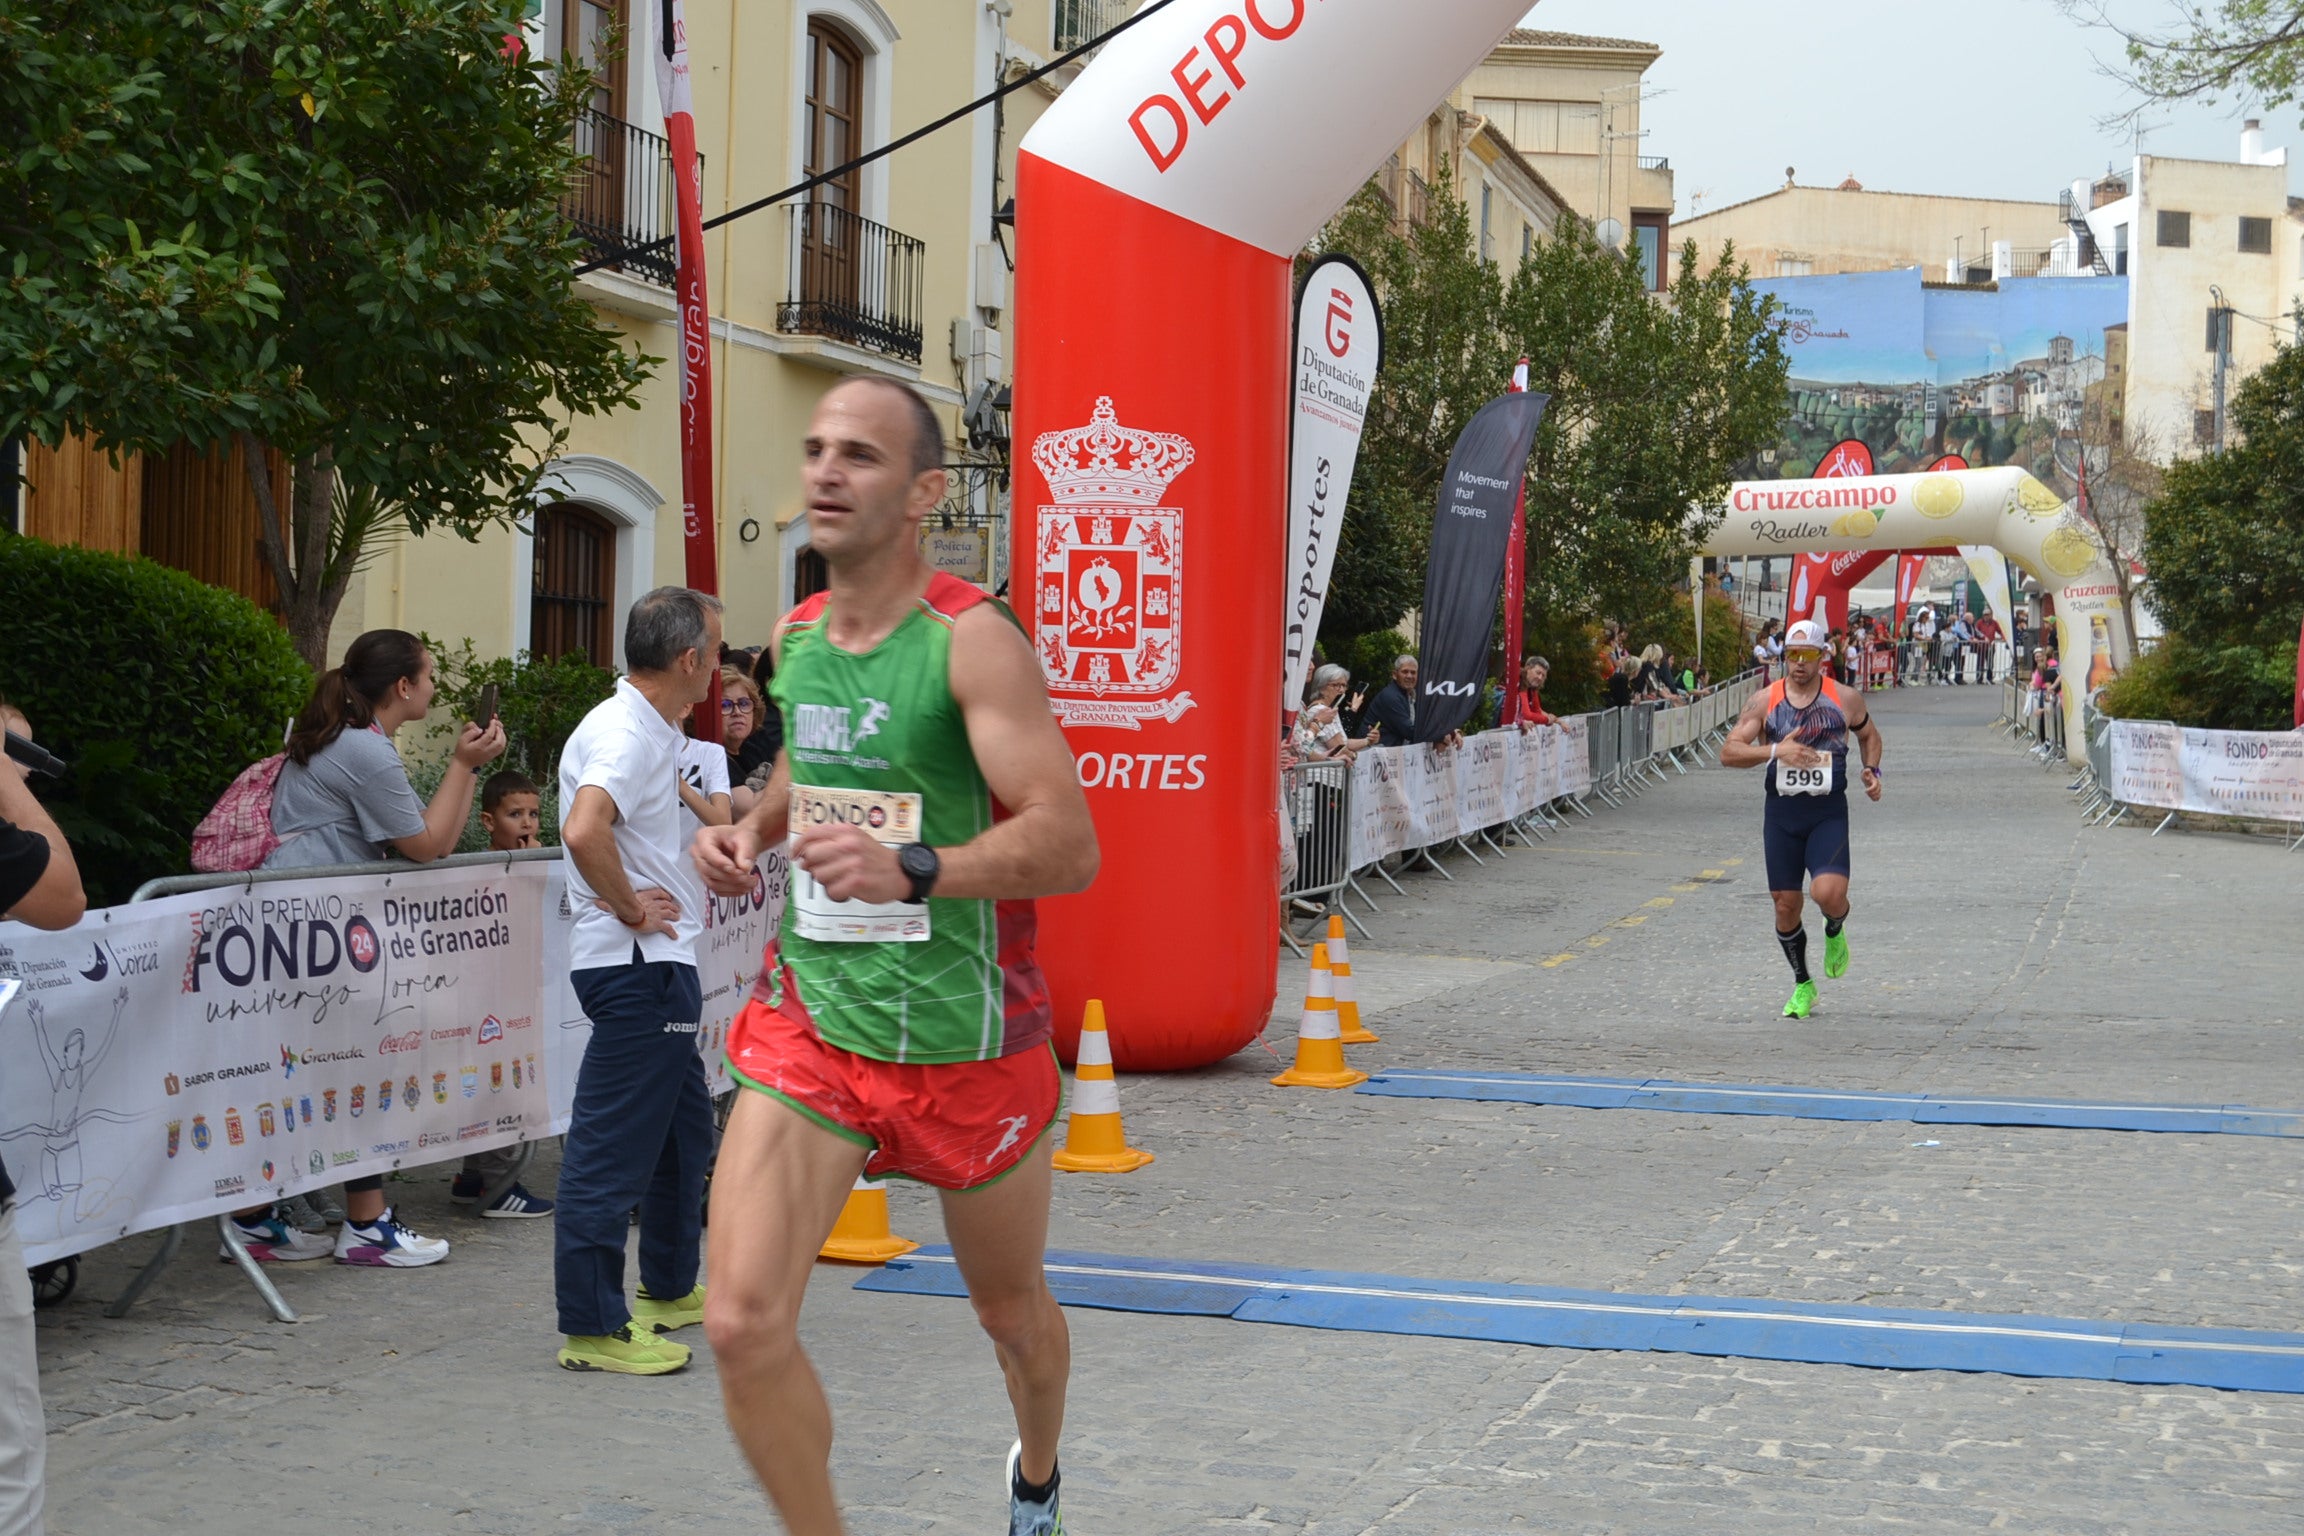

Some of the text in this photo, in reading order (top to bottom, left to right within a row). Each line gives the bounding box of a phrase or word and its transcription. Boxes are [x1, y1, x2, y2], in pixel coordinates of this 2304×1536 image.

[1127, 0, 1326, 174] DEPO
[1783, 302, 1814, 316] Turismo
[1303, 346, 1365, 392] Diputación
[1300, 373, 1365, 416] de Granada
[1299, 400, 1339, 425] Avanzamos
[1457, 470, 1510, 491] Movement
[1455, 486, 1475, 500] that
[1733, 485, 1896, 513] Cruzcampo
[1450, 502, 1488, 518] inspires
[1750, 518, 1829, 543] Radler
[936, 556, 969, 567] Local
[2070, 600, 2105, 613] Radler
[1070, 711, 1128, 723] GRANADA
[1070, 751, 1207, 790] ORTES
[1785, 769, 1825, 786] 599
[262, 895, 343, 925] PREMIO
[384, 887, 508, 933] Diputación
[352, 932, 374, 956] 24
[391, 919, 511, 960] de Granada
[104, 938, 159, 977] Lorca
[192, 914, 382, 993] FONDO
[21, 957, 67, 976] Diputación
[26, 973, 73, 992] de Granada
[300, 1047, 366, 1066] Granada
[184, 1061, 272, 1088] SABOR GRANADA
[214, 1174, 245, 1189] IDEAL
